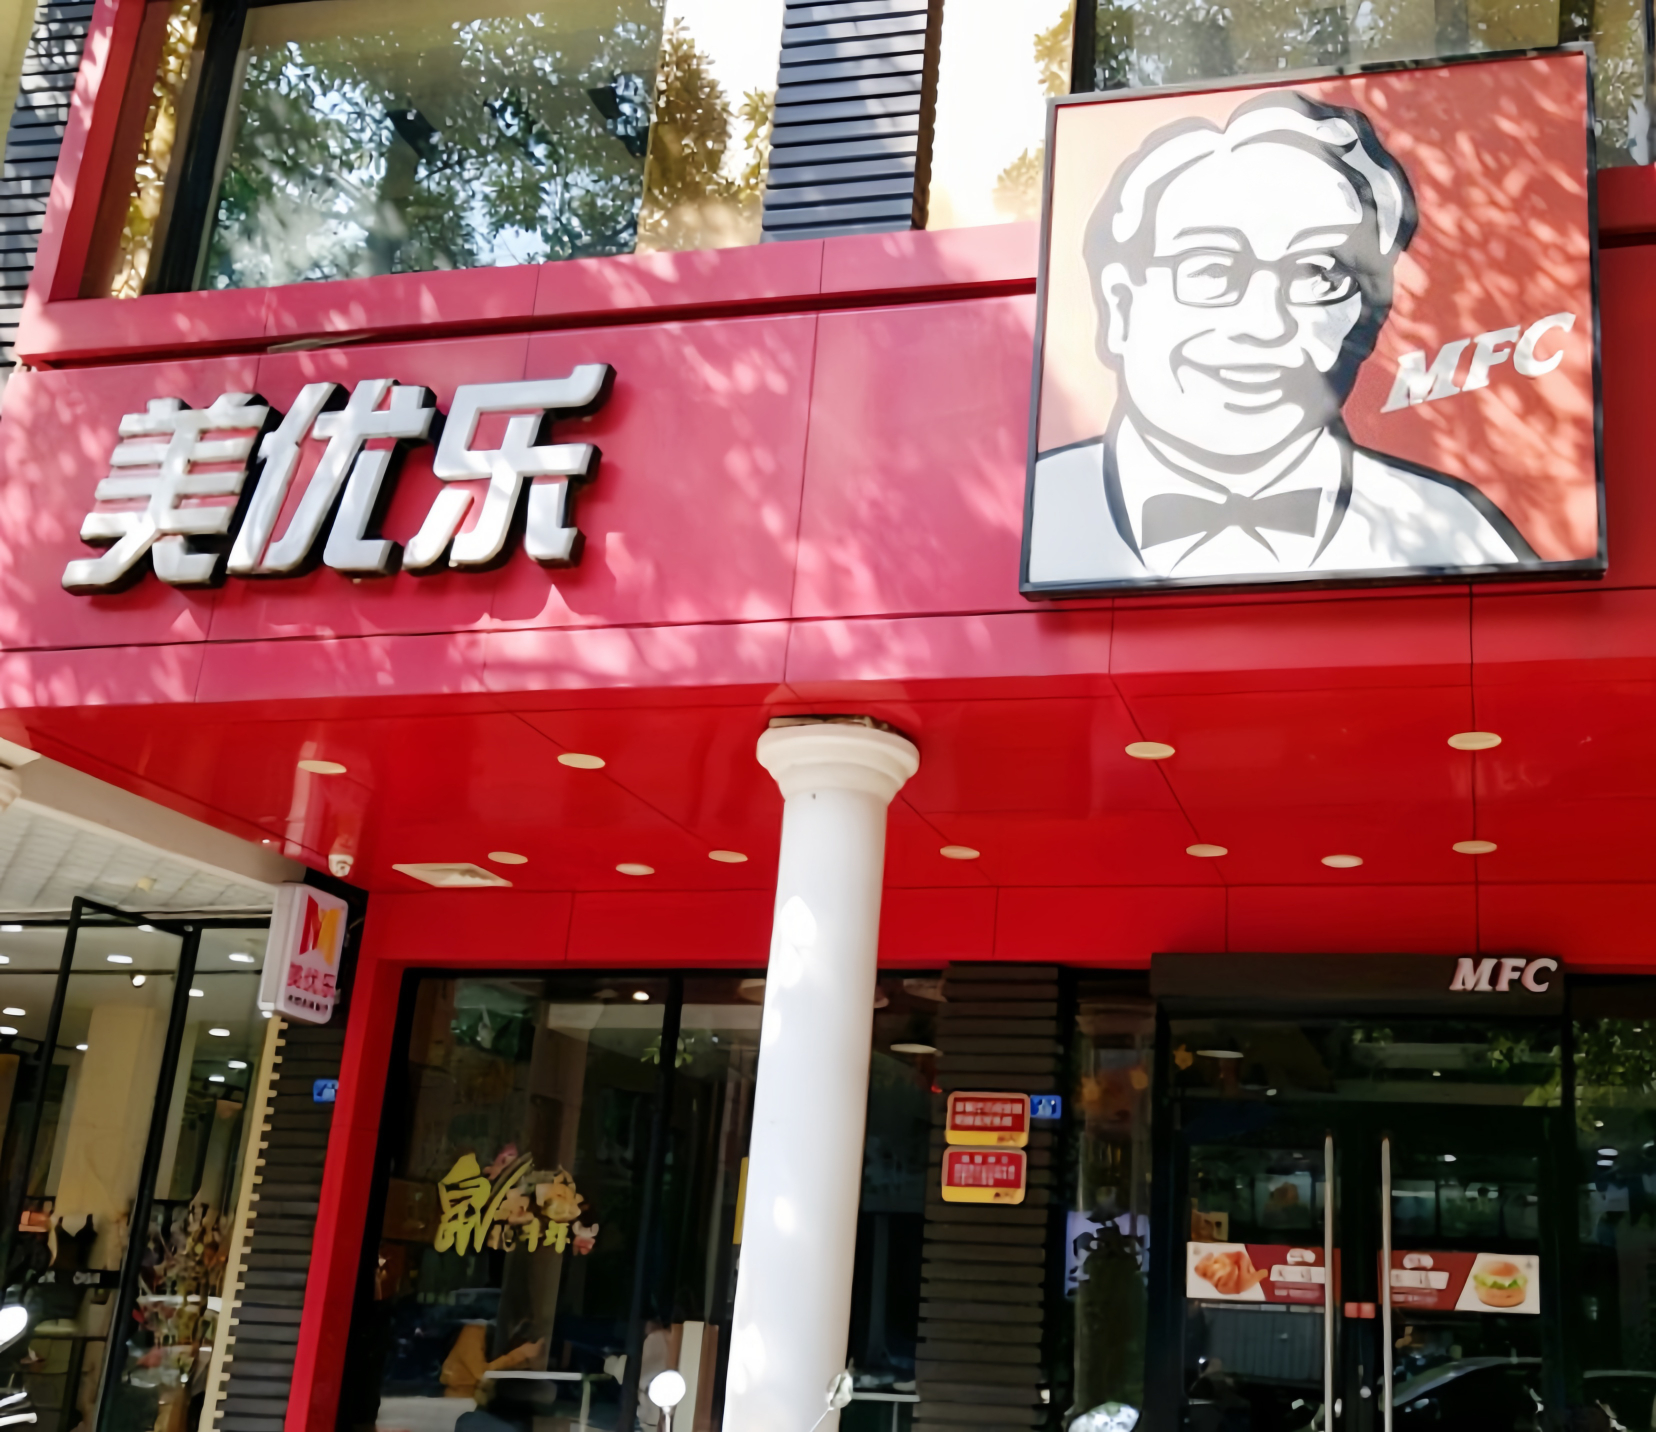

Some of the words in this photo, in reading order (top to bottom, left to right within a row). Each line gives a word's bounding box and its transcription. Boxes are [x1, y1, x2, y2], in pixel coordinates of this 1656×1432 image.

[1380, 312, 1576, 413] MFC
[62, 363, 614, 595] 美优乐
[1449, 957, 1558, 993] MFC
